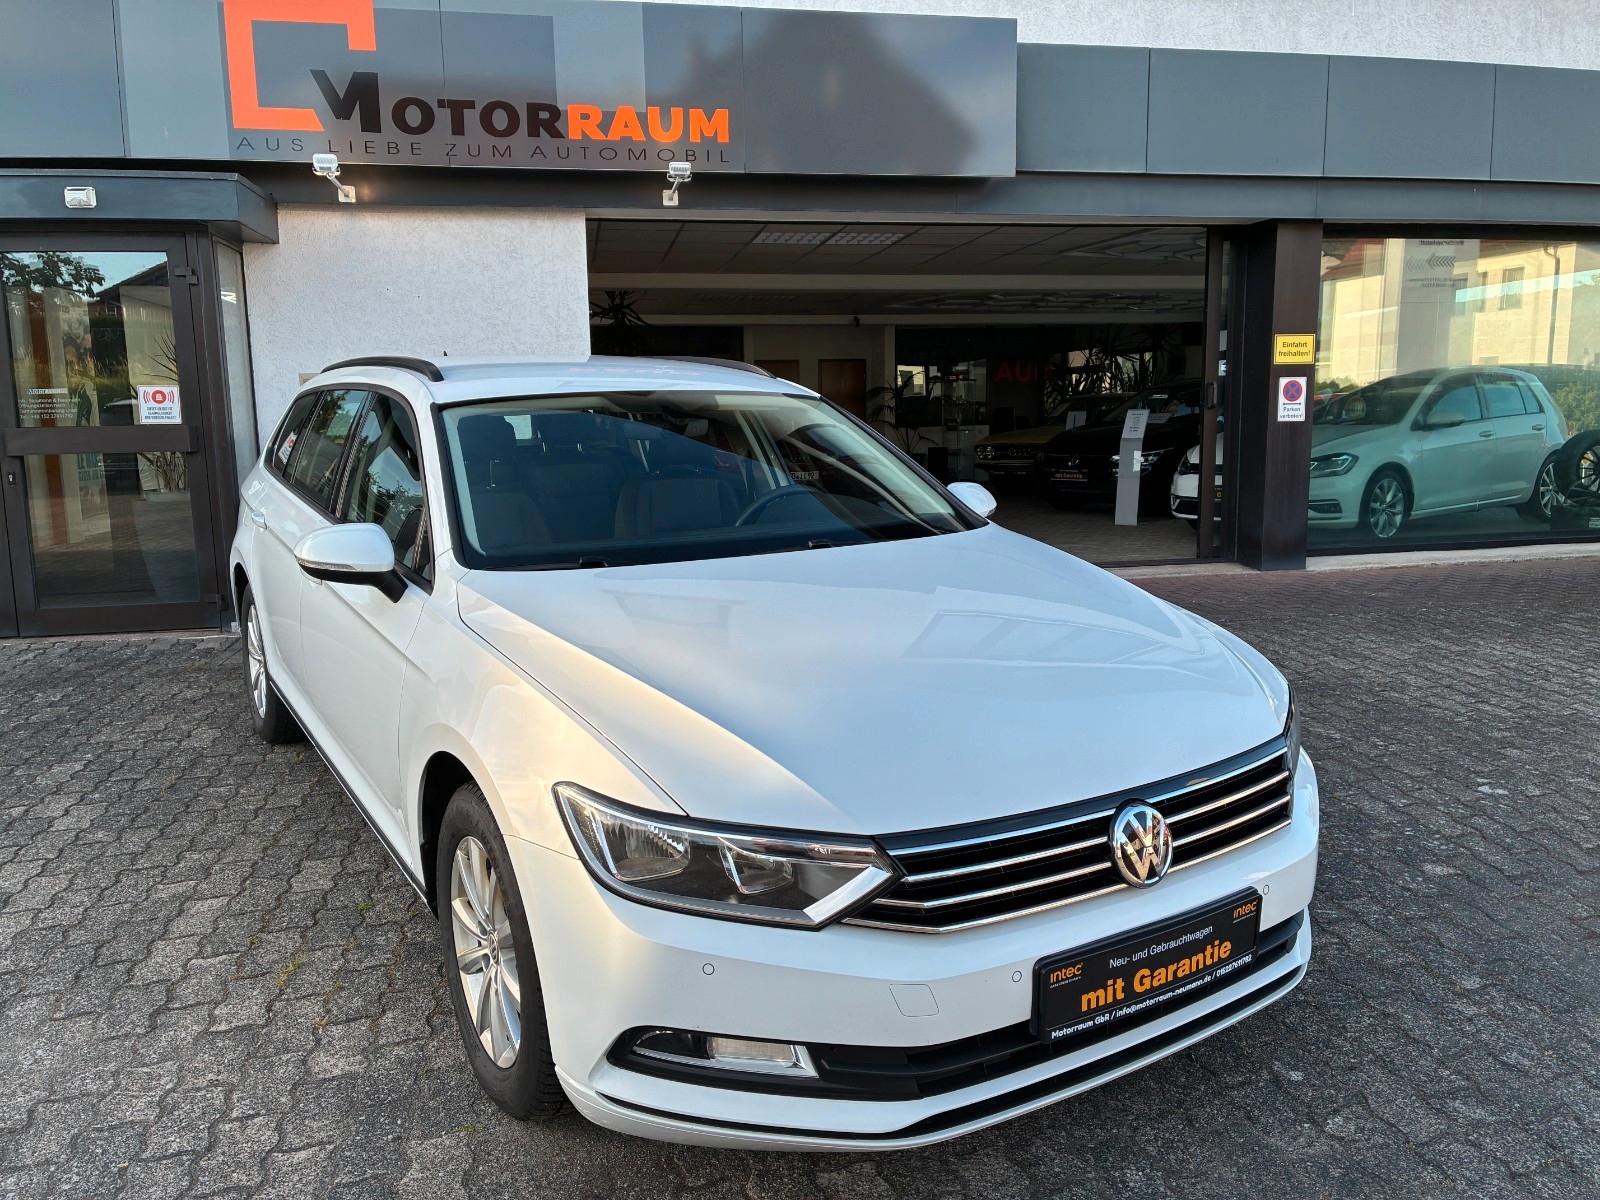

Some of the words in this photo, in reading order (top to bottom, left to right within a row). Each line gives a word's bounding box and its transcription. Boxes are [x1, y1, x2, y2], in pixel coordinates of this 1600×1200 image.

[236, 137, 305, 153] AUS
[327, 139, 424, 157] LIEBE
[444, 143, 513, 159] ZUM
[530, 146, 731, 164] AUTOMOBIL
[1233, 901, 1258, 919] intec
[1109, 957, 1131, 969] Neu-
[1132, 948, 1148, 962] und
[1150, 925, 1213, 955] Gebrauchtwagen
[1049, 964, 1083, 984] intec
[1081, 977, 1125, 1012] mit
[1133, 939, 1232, 993] Garantie
[1051, 1020, 1094, 1039] Motorraum
[1094, 1013, 1110, 1025] GbR
[1116, 974, 1212, 1018] info@motorraum-neumann.de
